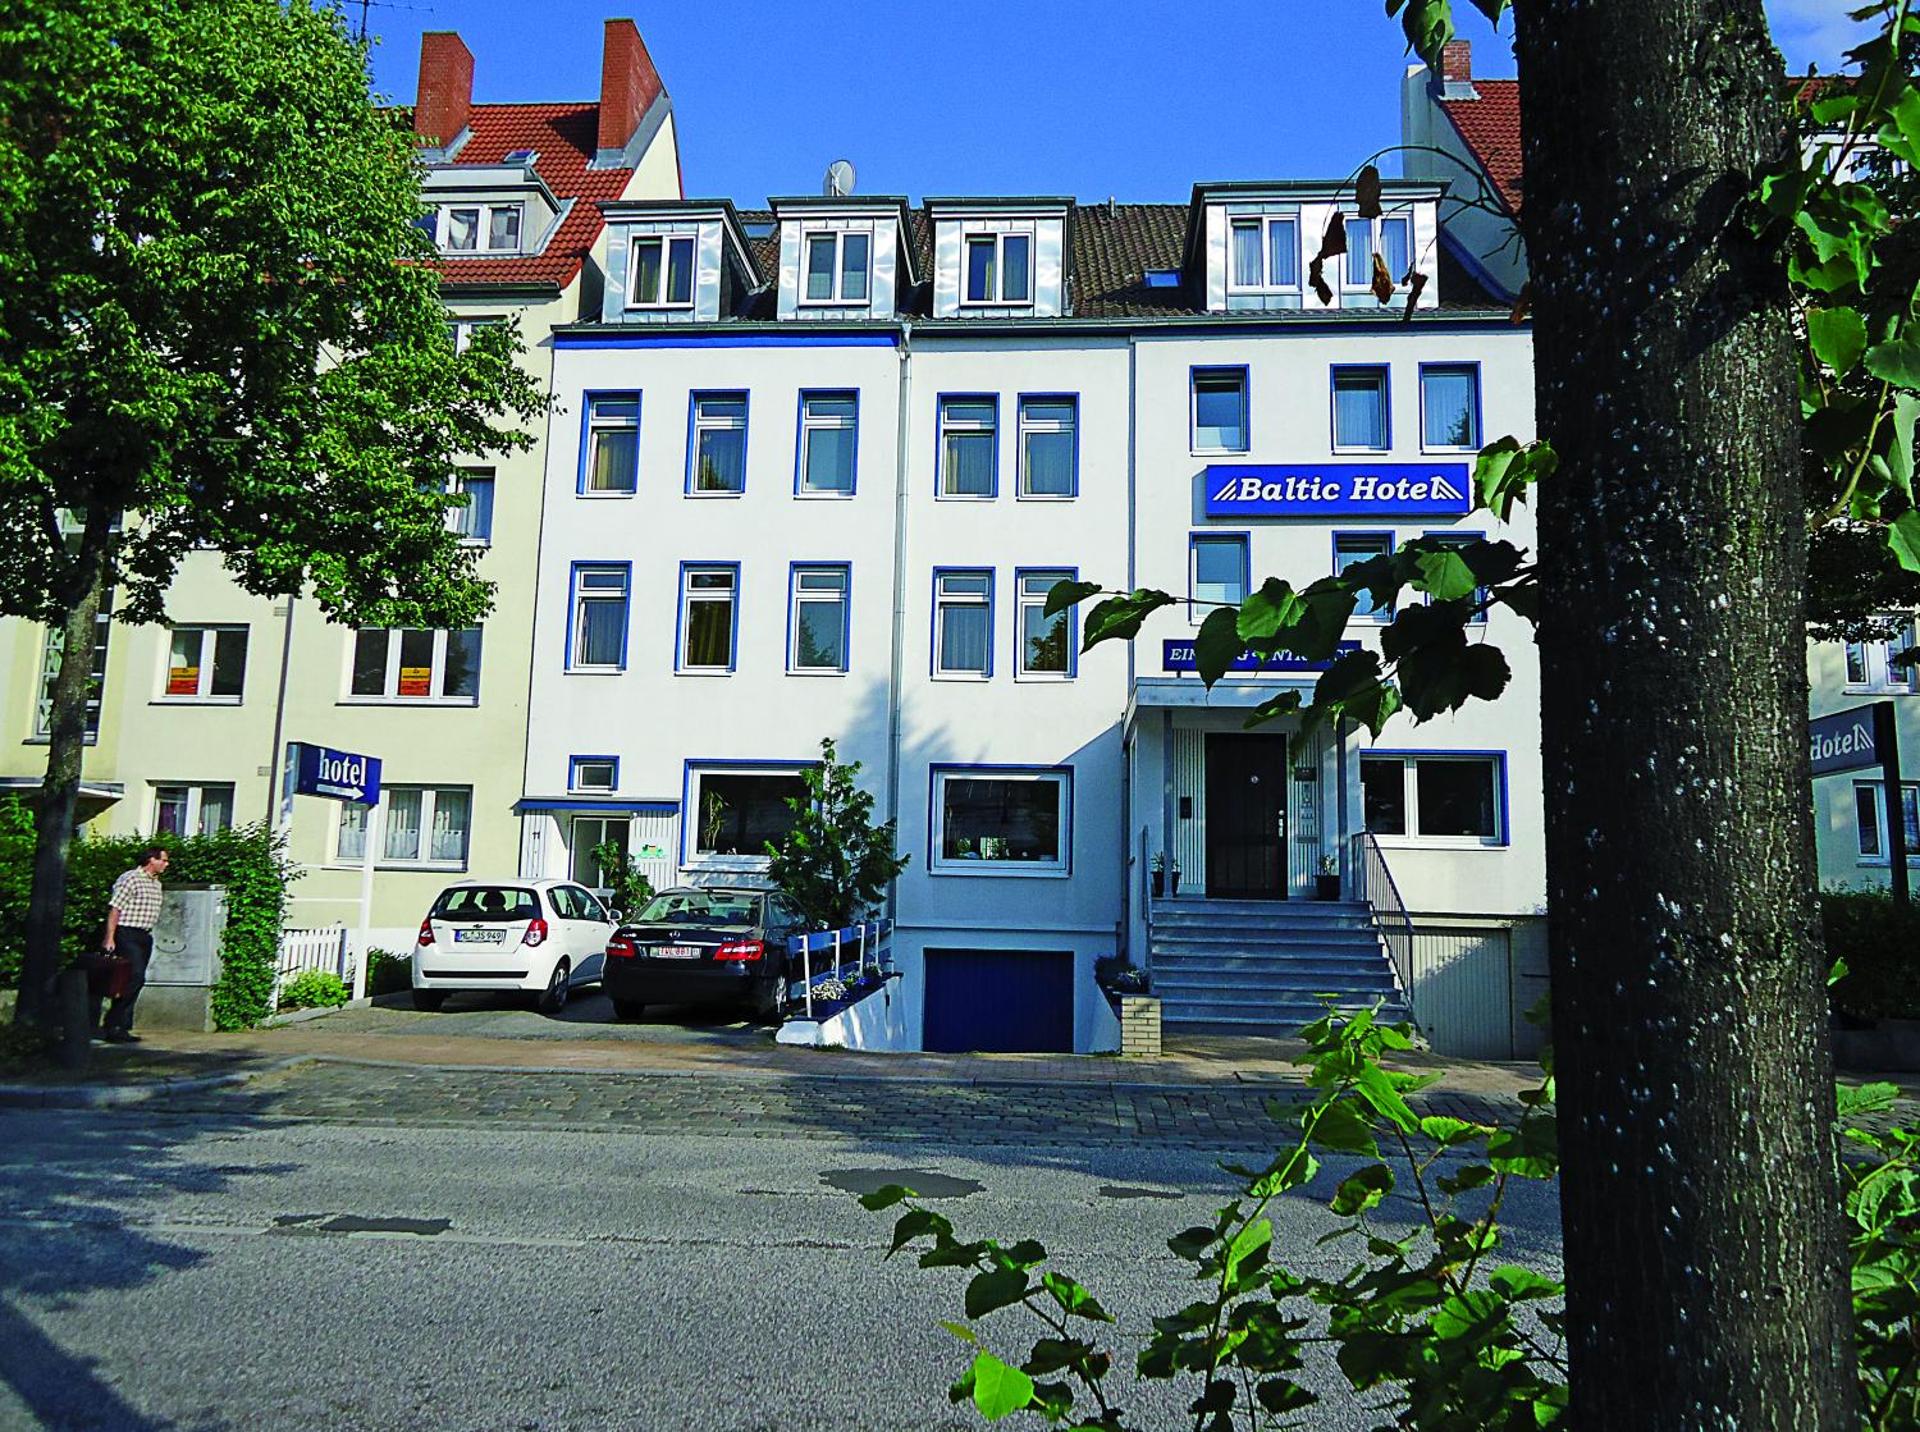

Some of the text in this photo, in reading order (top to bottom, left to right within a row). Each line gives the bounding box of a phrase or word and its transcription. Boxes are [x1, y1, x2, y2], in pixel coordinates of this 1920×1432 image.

[1237, 475, 1443, 501] Baltic Hotel
[1810, 723, 1860, 760] Hotel
[318, 750, 366, 787] hotel
